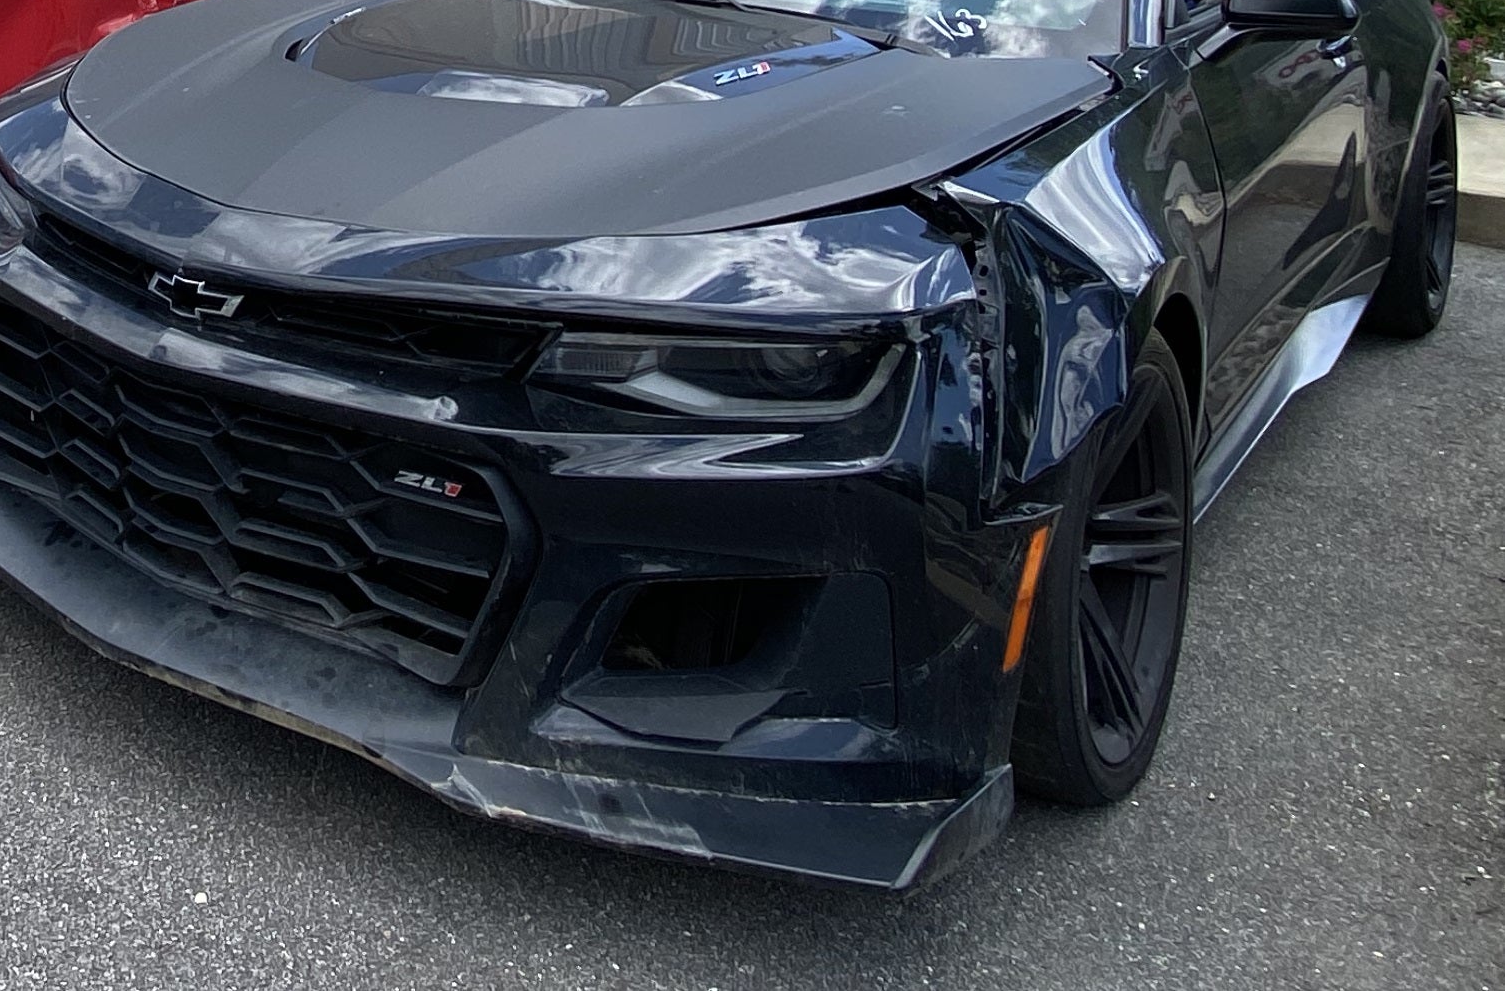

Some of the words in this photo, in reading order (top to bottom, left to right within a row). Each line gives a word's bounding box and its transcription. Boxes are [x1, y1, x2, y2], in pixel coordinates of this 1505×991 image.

[925, 8, 988, 41] 163
[713, 61, 771, 86] ZL1
[394, 470, 463, 497] ZL1
